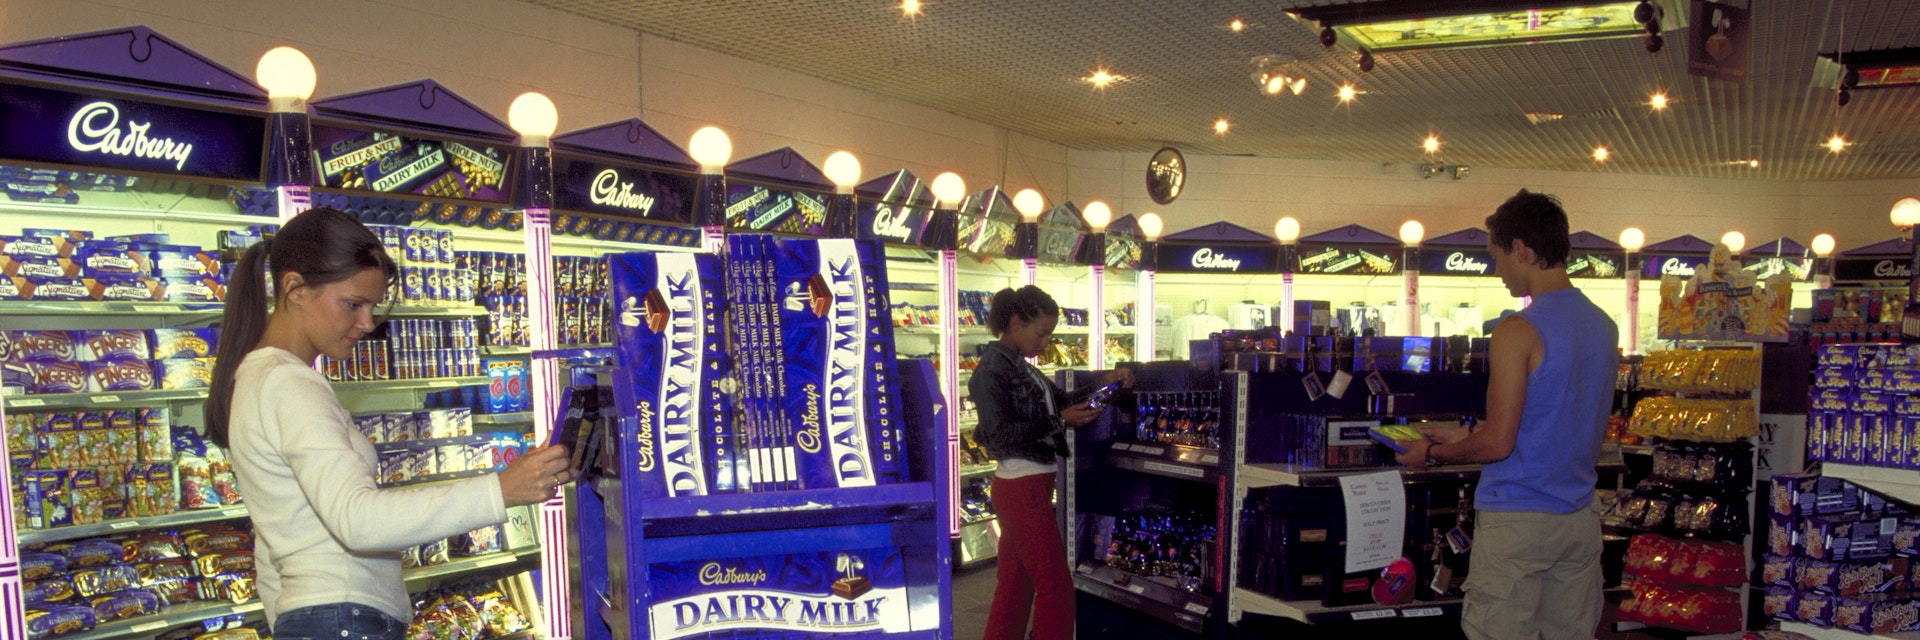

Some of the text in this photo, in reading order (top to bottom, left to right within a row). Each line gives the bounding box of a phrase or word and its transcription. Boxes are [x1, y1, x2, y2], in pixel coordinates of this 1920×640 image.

[68, 101, 192, 170] Cadbury
[329, 139, 397, 171] FRUIT & NUT
[444, 141, 498, 171] WHOLE NUT
[378, 152, 440, 191] DAIRY MILK
[590, 168, 655, 217] Cadbury
[753, 201, 790, 229] DAIRY MILK
[1191, 248, 1240, 271] Cadbury
[1445, 252, 1488, 274] Cadbury
[1662, 257, 1695, 275] Cadbu
[1874, 260, 1911, 277] Cadbu
[760, 304, 768, 327] DAIRY
[772, 303, 780, 326] DAIRY
[13, 335, 70, 360] FINGERS
[89, 334, 145, 360] FINGERS
[737, 304, 745, 327] DAIRY
[743, 367, 751, 398] Chocolate
[748, 304, 756, 327] DAIRY
[754, 366, 762, 398] Chocolate
[762, 328, 770, 347] MILK
[774, 327, 782, 347] MILK
[36, 368, 82, 387] NGERS
[94, 367, 150, 391] FINGERS
[661, 269, 701, 497] DAIRY MILK
[705, 290, 726, 469] HOCOLATE & A HALF
[778, 365, 786, 397] Chocolate
[828, 255, 870, 482] DAIRY MILK
[865, 275, 892, 462] CHOCOLATE & A HALF
[796, 383, 822, 453] Cadbury's
[637, 401, 656, 472] Cadbury's
[699, 562, 766, 587] Cadbury's
[673, 595, 888, 631] DAIRY MILK
